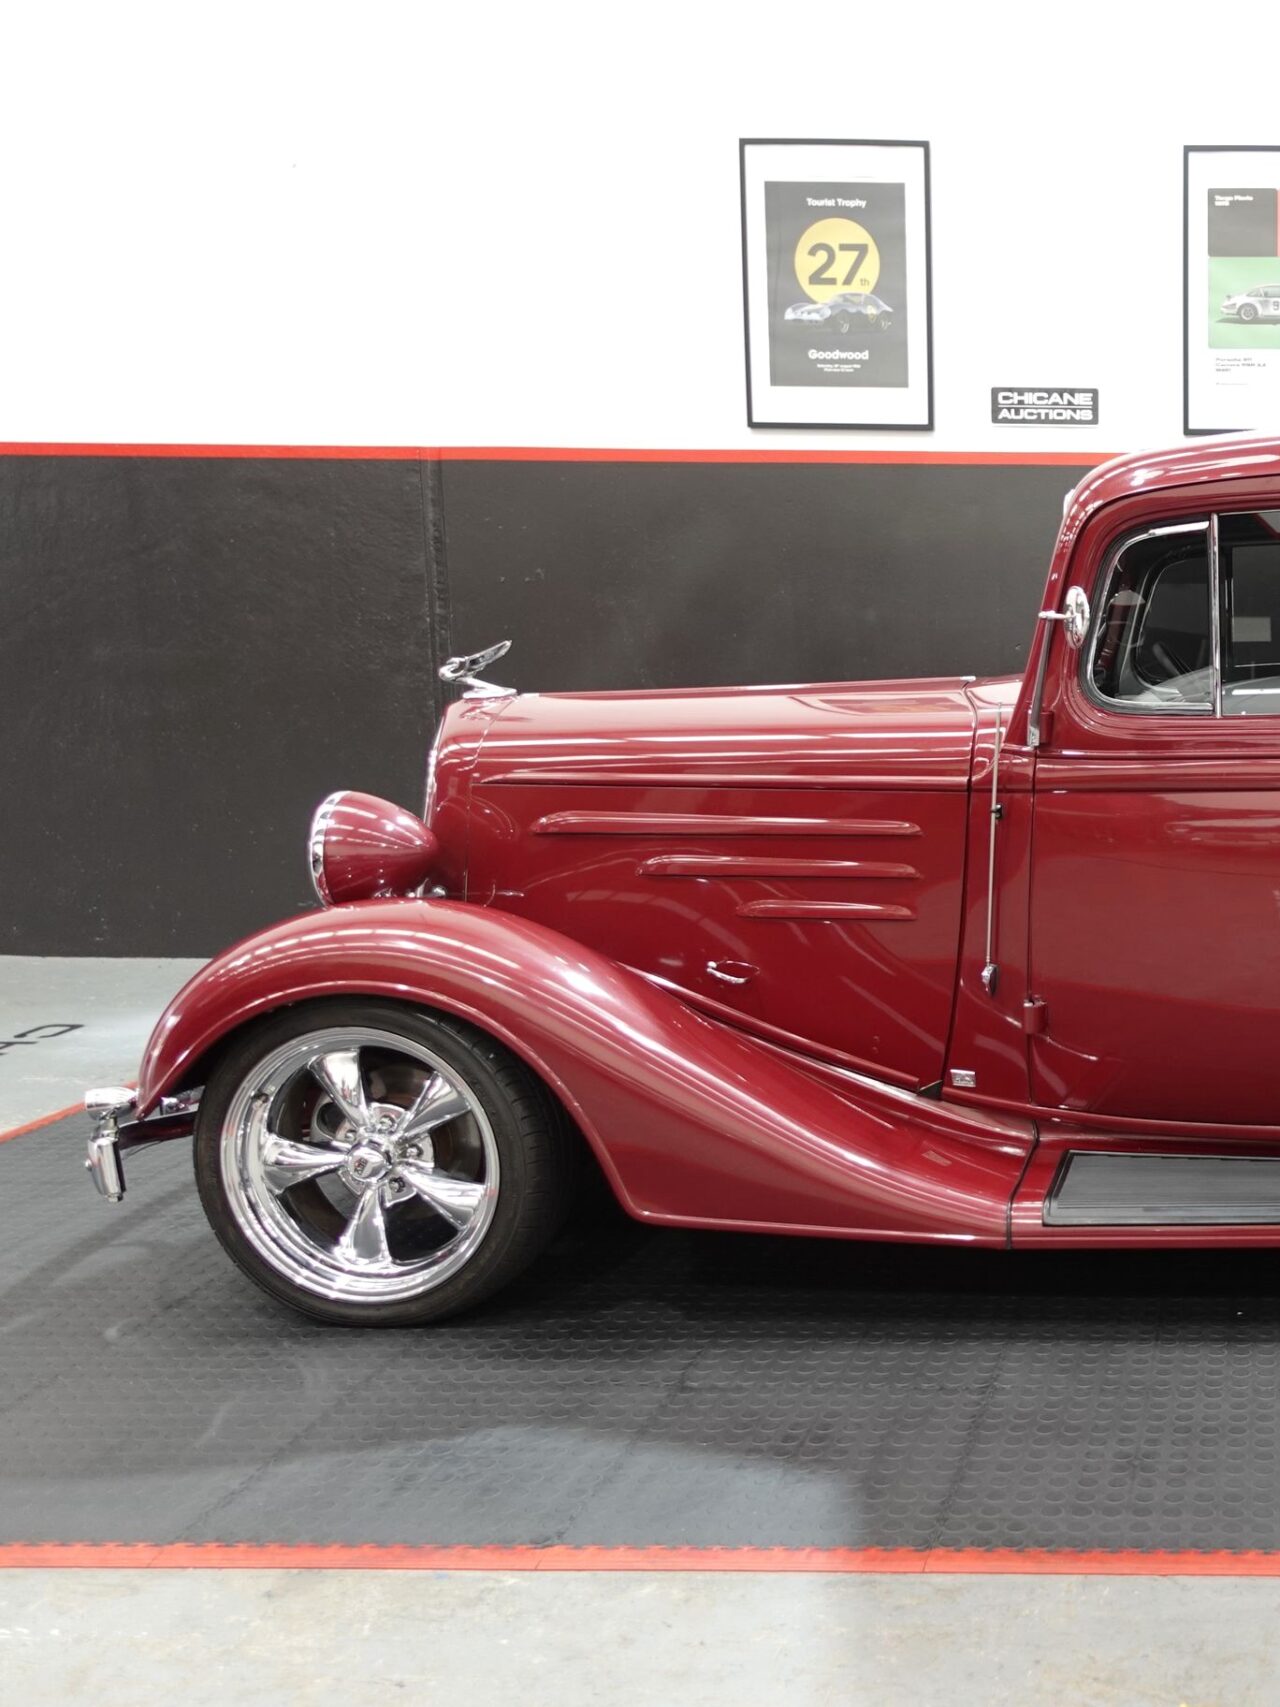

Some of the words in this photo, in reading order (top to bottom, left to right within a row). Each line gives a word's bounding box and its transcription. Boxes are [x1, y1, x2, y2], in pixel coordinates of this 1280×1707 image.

[806, 197, 836, 207] Tourist
[837, 198, 867, 209] Trophy
[808, 349, 869, 360] Goodwood
[998, 391, 1093, 405] CHICANE
[998, 408, 1093, 421] AUCTIONS
